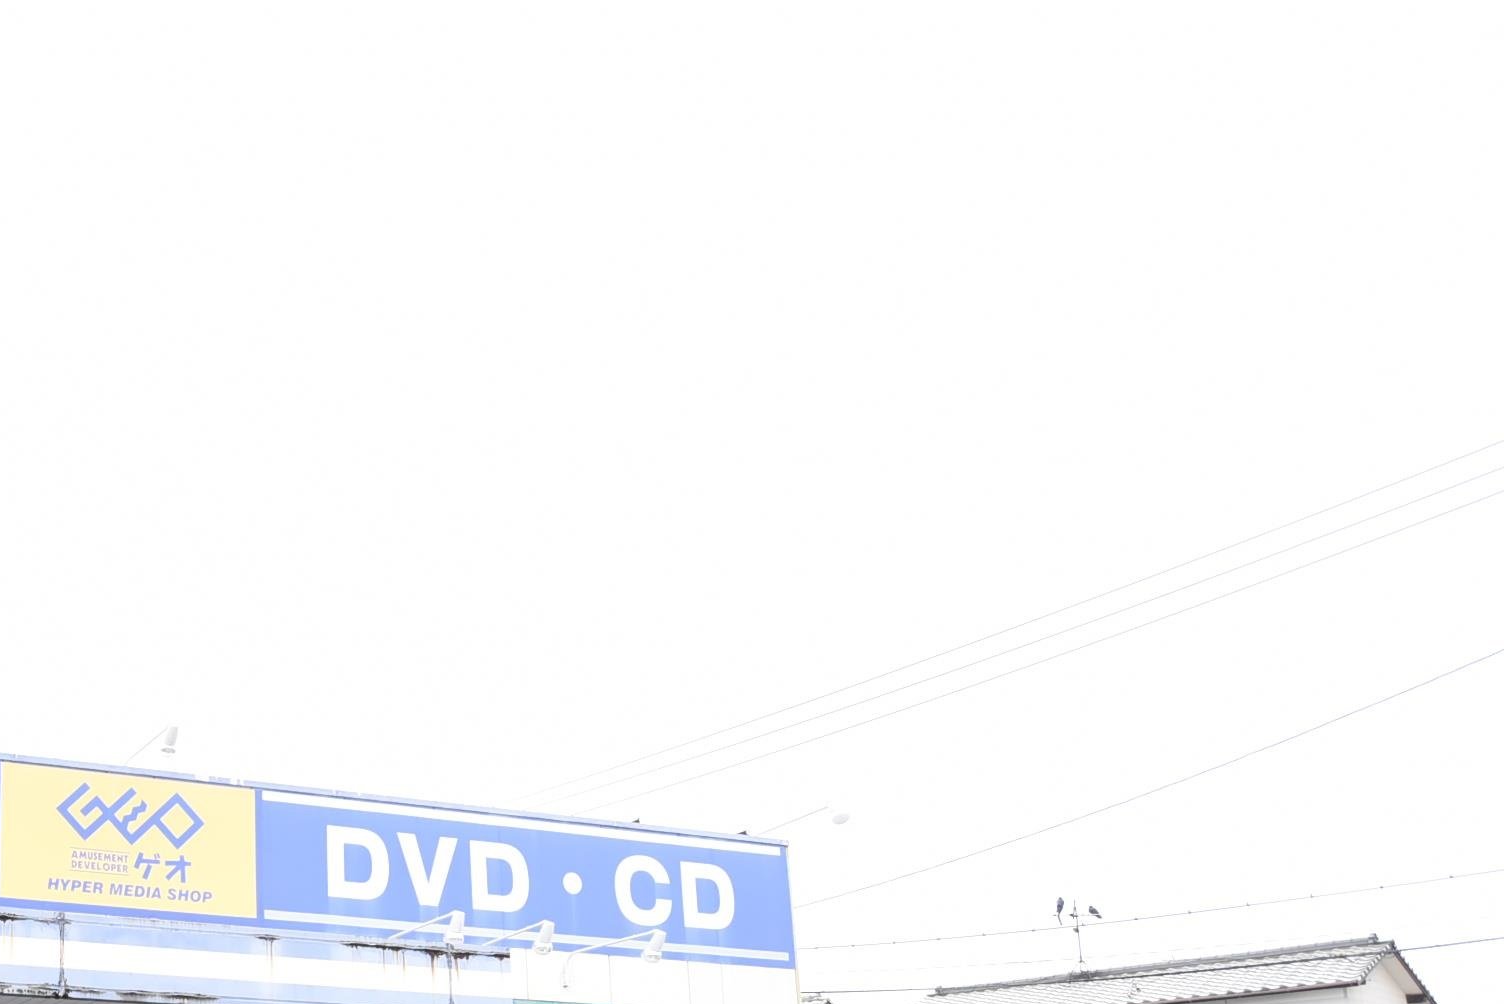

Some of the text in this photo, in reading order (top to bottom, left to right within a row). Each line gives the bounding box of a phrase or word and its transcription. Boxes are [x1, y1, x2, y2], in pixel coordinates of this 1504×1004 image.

[56, 782, 205, 850] GEO
[71, 850, 129, 863] AMUSEMENT
[71, 860, 129, 873] DEVELOPER
[134, 852, 192, 884] ゲオ
[48, 878, 213, 903] HYPER MEDIA SHOP
